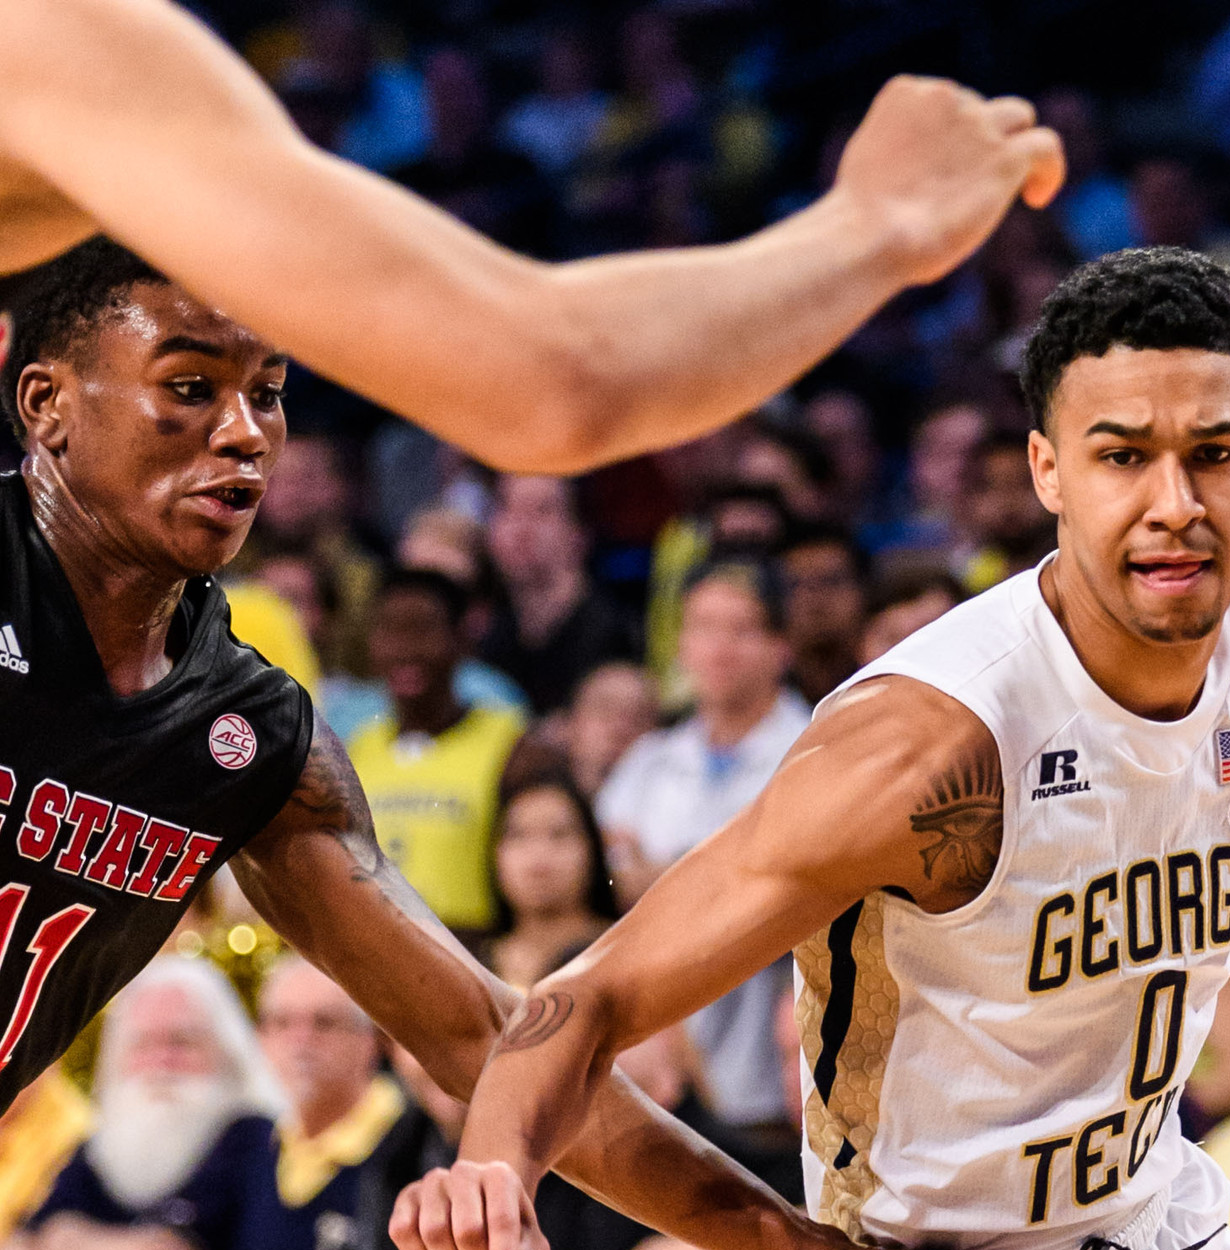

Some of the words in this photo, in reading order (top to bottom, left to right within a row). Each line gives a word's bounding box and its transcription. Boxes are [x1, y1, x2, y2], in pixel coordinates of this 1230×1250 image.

[215, 731, 254, 750] ACC
[1039, 749, 1078, 785] R
[1031, 780, 1091, 801] RUSSELL
[17, 778, 223, 902] STATE
[1127, 968, 1191, 1102] 0
